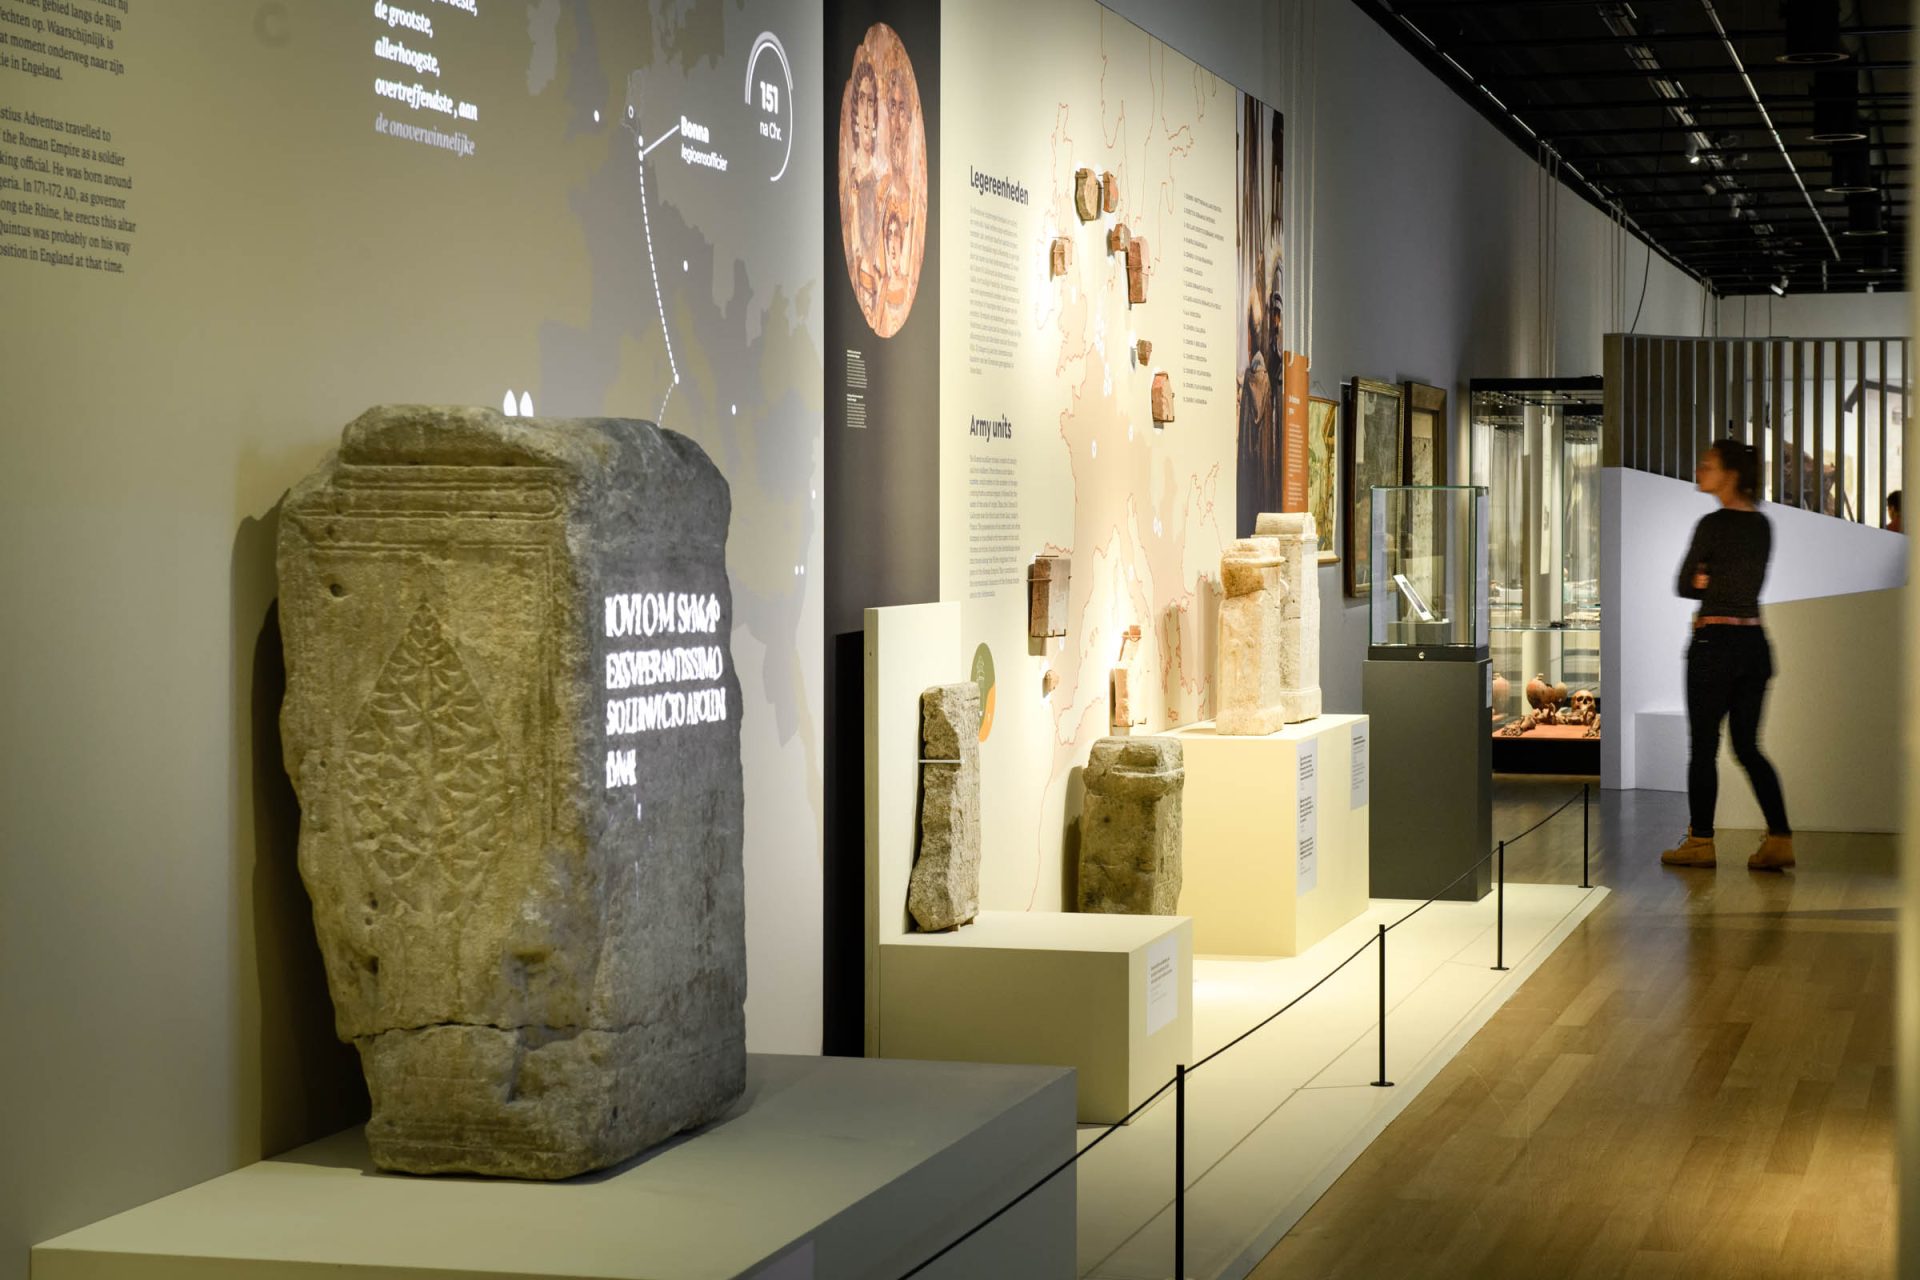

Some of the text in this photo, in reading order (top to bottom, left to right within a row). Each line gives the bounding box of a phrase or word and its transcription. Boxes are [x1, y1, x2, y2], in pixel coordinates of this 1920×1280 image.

[0, 6, 114, 50] echten op. Waarschijnlijk is
[42, 0, 69, 15] gebied
[71, 3, 92, 24] langs
[94, 11, 104, 25] de
[105, 13, 121, 32] Rijn
[374, 0, 433, 38] de grootste,
[10, 35, 46, 54] moment
[48, 45, 89, 68] onderweg
[90, 56, 107, 70] naar
[109, 59, 124, 76] zijn
[11, 54, 19, 70] in
[22, 57, 63, 80] Engeland.
[375, 36, 440, 77] allerhoogste,
[459, 101, 478, 121] aan
[760, 81, 779, 115] 151
[24, 111, 64, 131] Adventus
[65, 121, 101, 140] travelled
[102, 129, 112, 142] to
[375, 112, 475, 157] de onoverwinnelijke
[681, 115, 710, 144] Bonna
[760, 121, 782, 141] na Chr.
[2, 129, 125, 166] the Roman Empire as a soldier
[681, 143, 728, 172] legioensofficier
[20, 156, 51, 173] official.
[52, 161, 64, 176] He
[66, 167, 82, 180] was
[84, 168, 103, 184] born
[104, 175, 132, 189] around
[970, 165, 1029, 206] Legereenheden
[23, 178, 32, 193] In
[33, 179, 61, 198] 171-172
[80, 192, 89, 203] as
[90, 194, 126, 210] governor
[19, 200, 33, 215] the
[35, 202, 61, 222] Rhine,
[63, 207, 73, 222] he
[75, 213, 100, 226] erects
[101, 215, 116, 230] this
[118, 217, 136, 233] altar
[33, 228, 49, 240] was
[51, 230, 87, 249] probably
[89, 237, 100, 248] on
[101, 236, 113, 251] his
[114, 241, 131, 256] way
[30, 245, 38, 261] in
[40, 248, 73, 266] England
[75, 256, 83, 267] at
[85, 255, 102, 271] that
[104, 257, 124, 273] time.
[970, 413, 1012, 443] Army units
